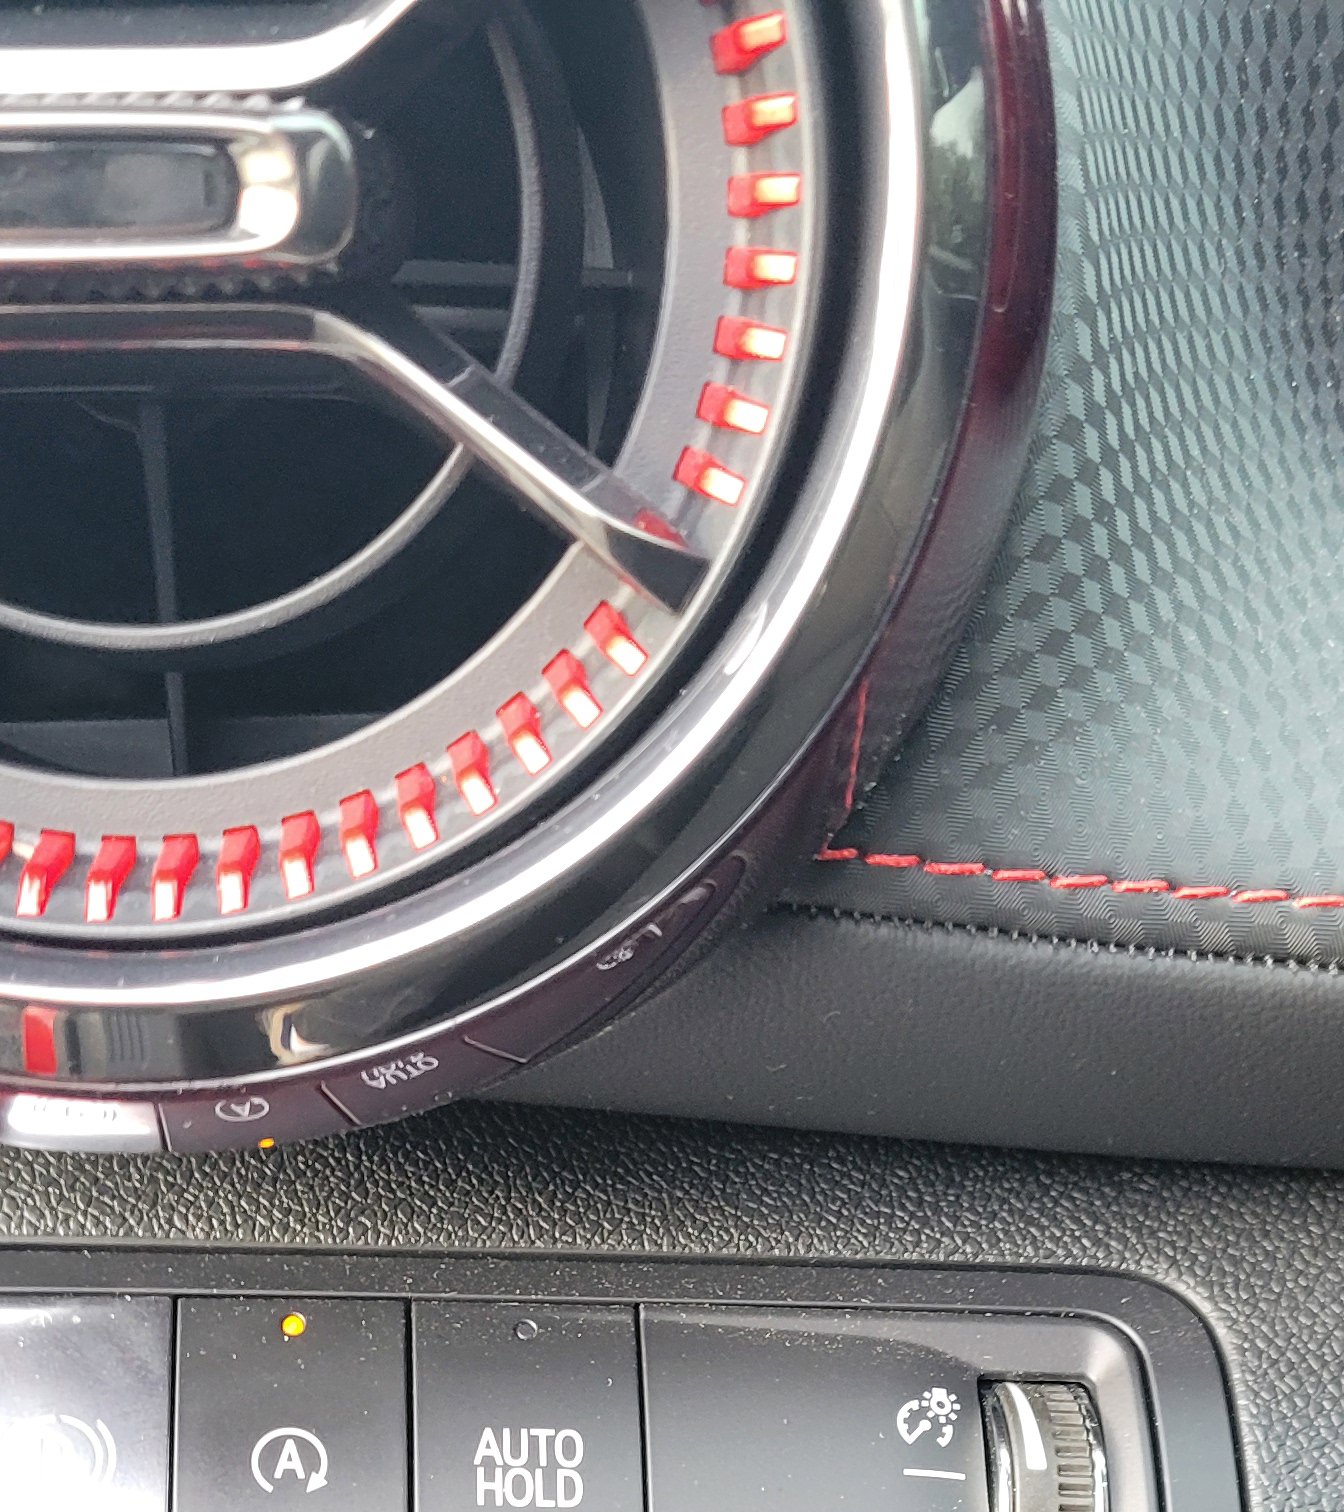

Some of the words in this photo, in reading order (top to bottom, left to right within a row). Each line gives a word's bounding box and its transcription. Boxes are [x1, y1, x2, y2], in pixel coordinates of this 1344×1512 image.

[273, 1438, 306, 1479] A
[473, 1427, 584, 1468] AUTO
[476, 1467, 584, 1508] HOLD
